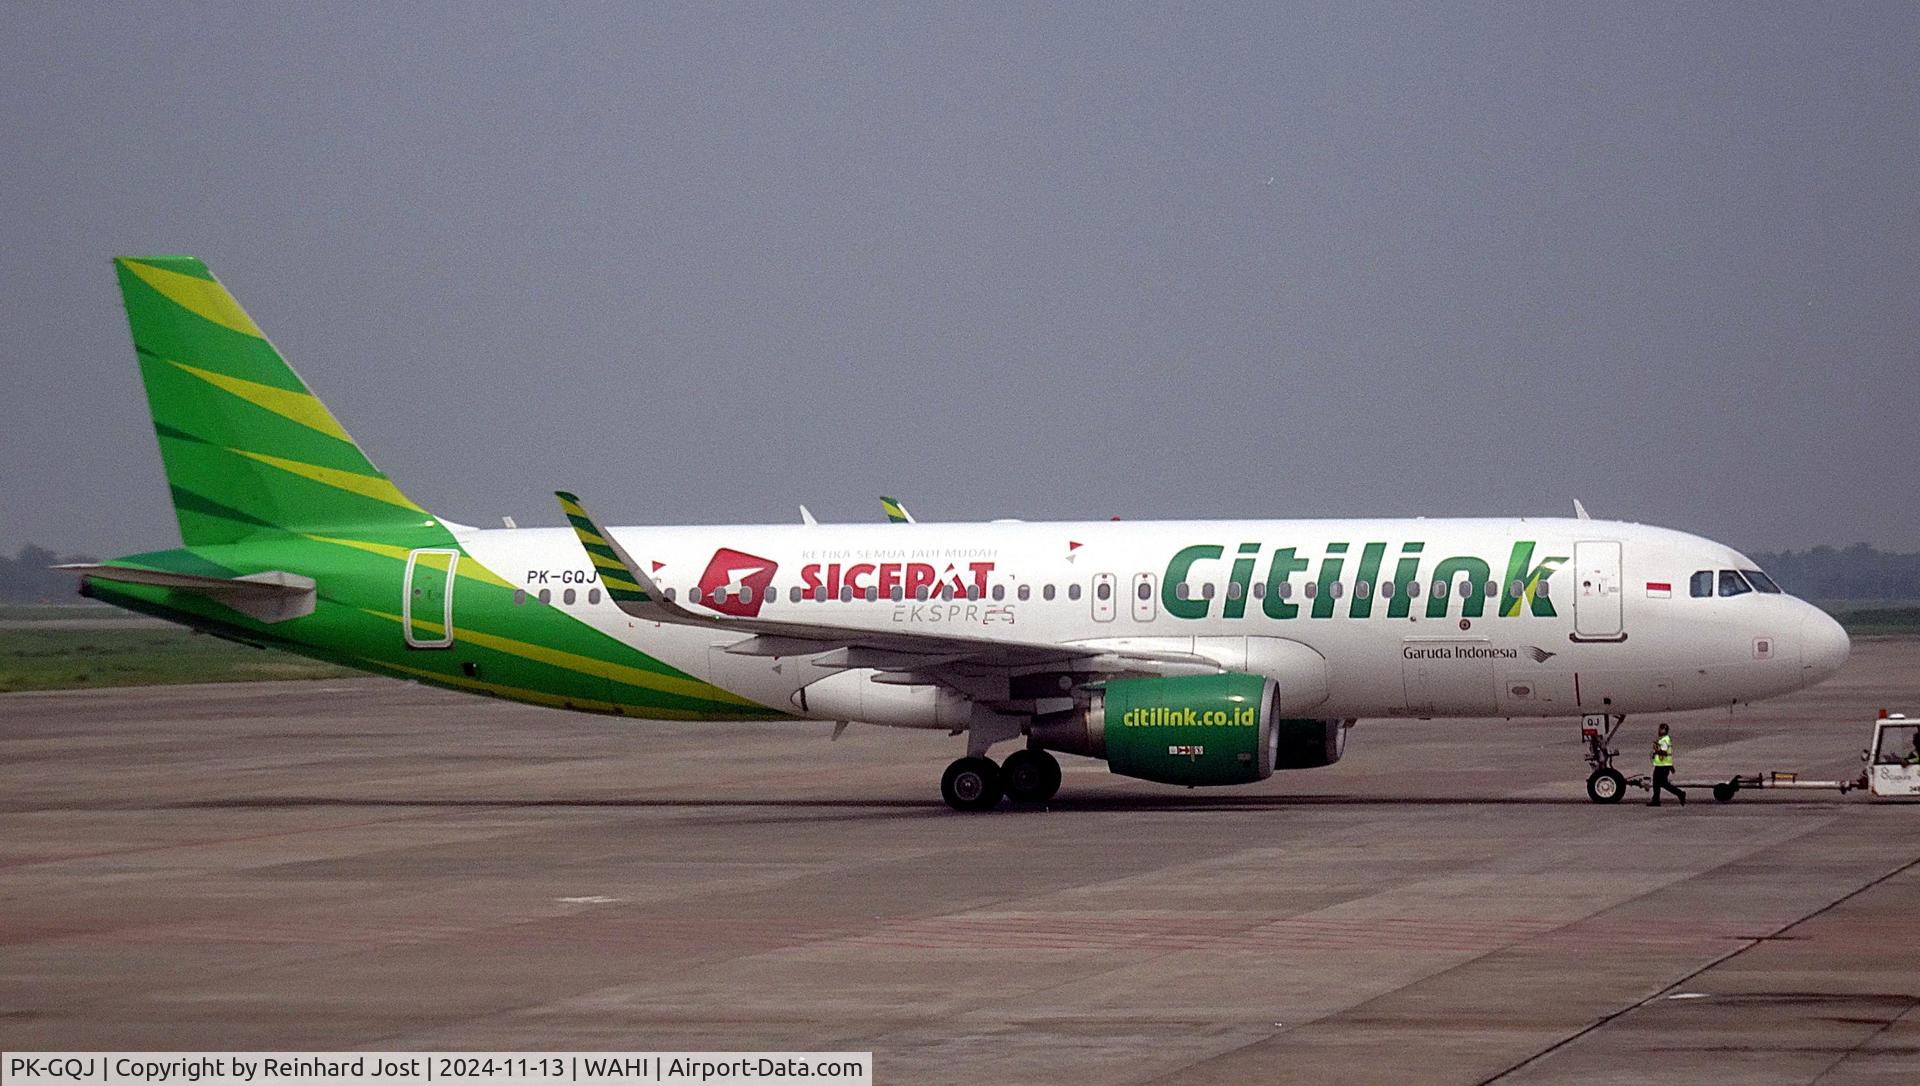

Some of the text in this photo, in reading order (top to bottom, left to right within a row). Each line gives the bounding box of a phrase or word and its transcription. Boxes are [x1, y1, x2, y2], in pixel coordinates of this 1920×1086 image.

[802, 548, 998, 560] KETIKA SEMUA JADI MUDAH
[527, 570, 598, 584] PK-GQJ
[801, 562, 995, 600] SICEPAT
[1161, 541, 1569, 619] Citilink
[893, 604, 1016, 623] EKSPRES
[1403, 646, 1518, 660] Garuda Indonesia
[1123, 707, 1255, 727] citilink.co.id
